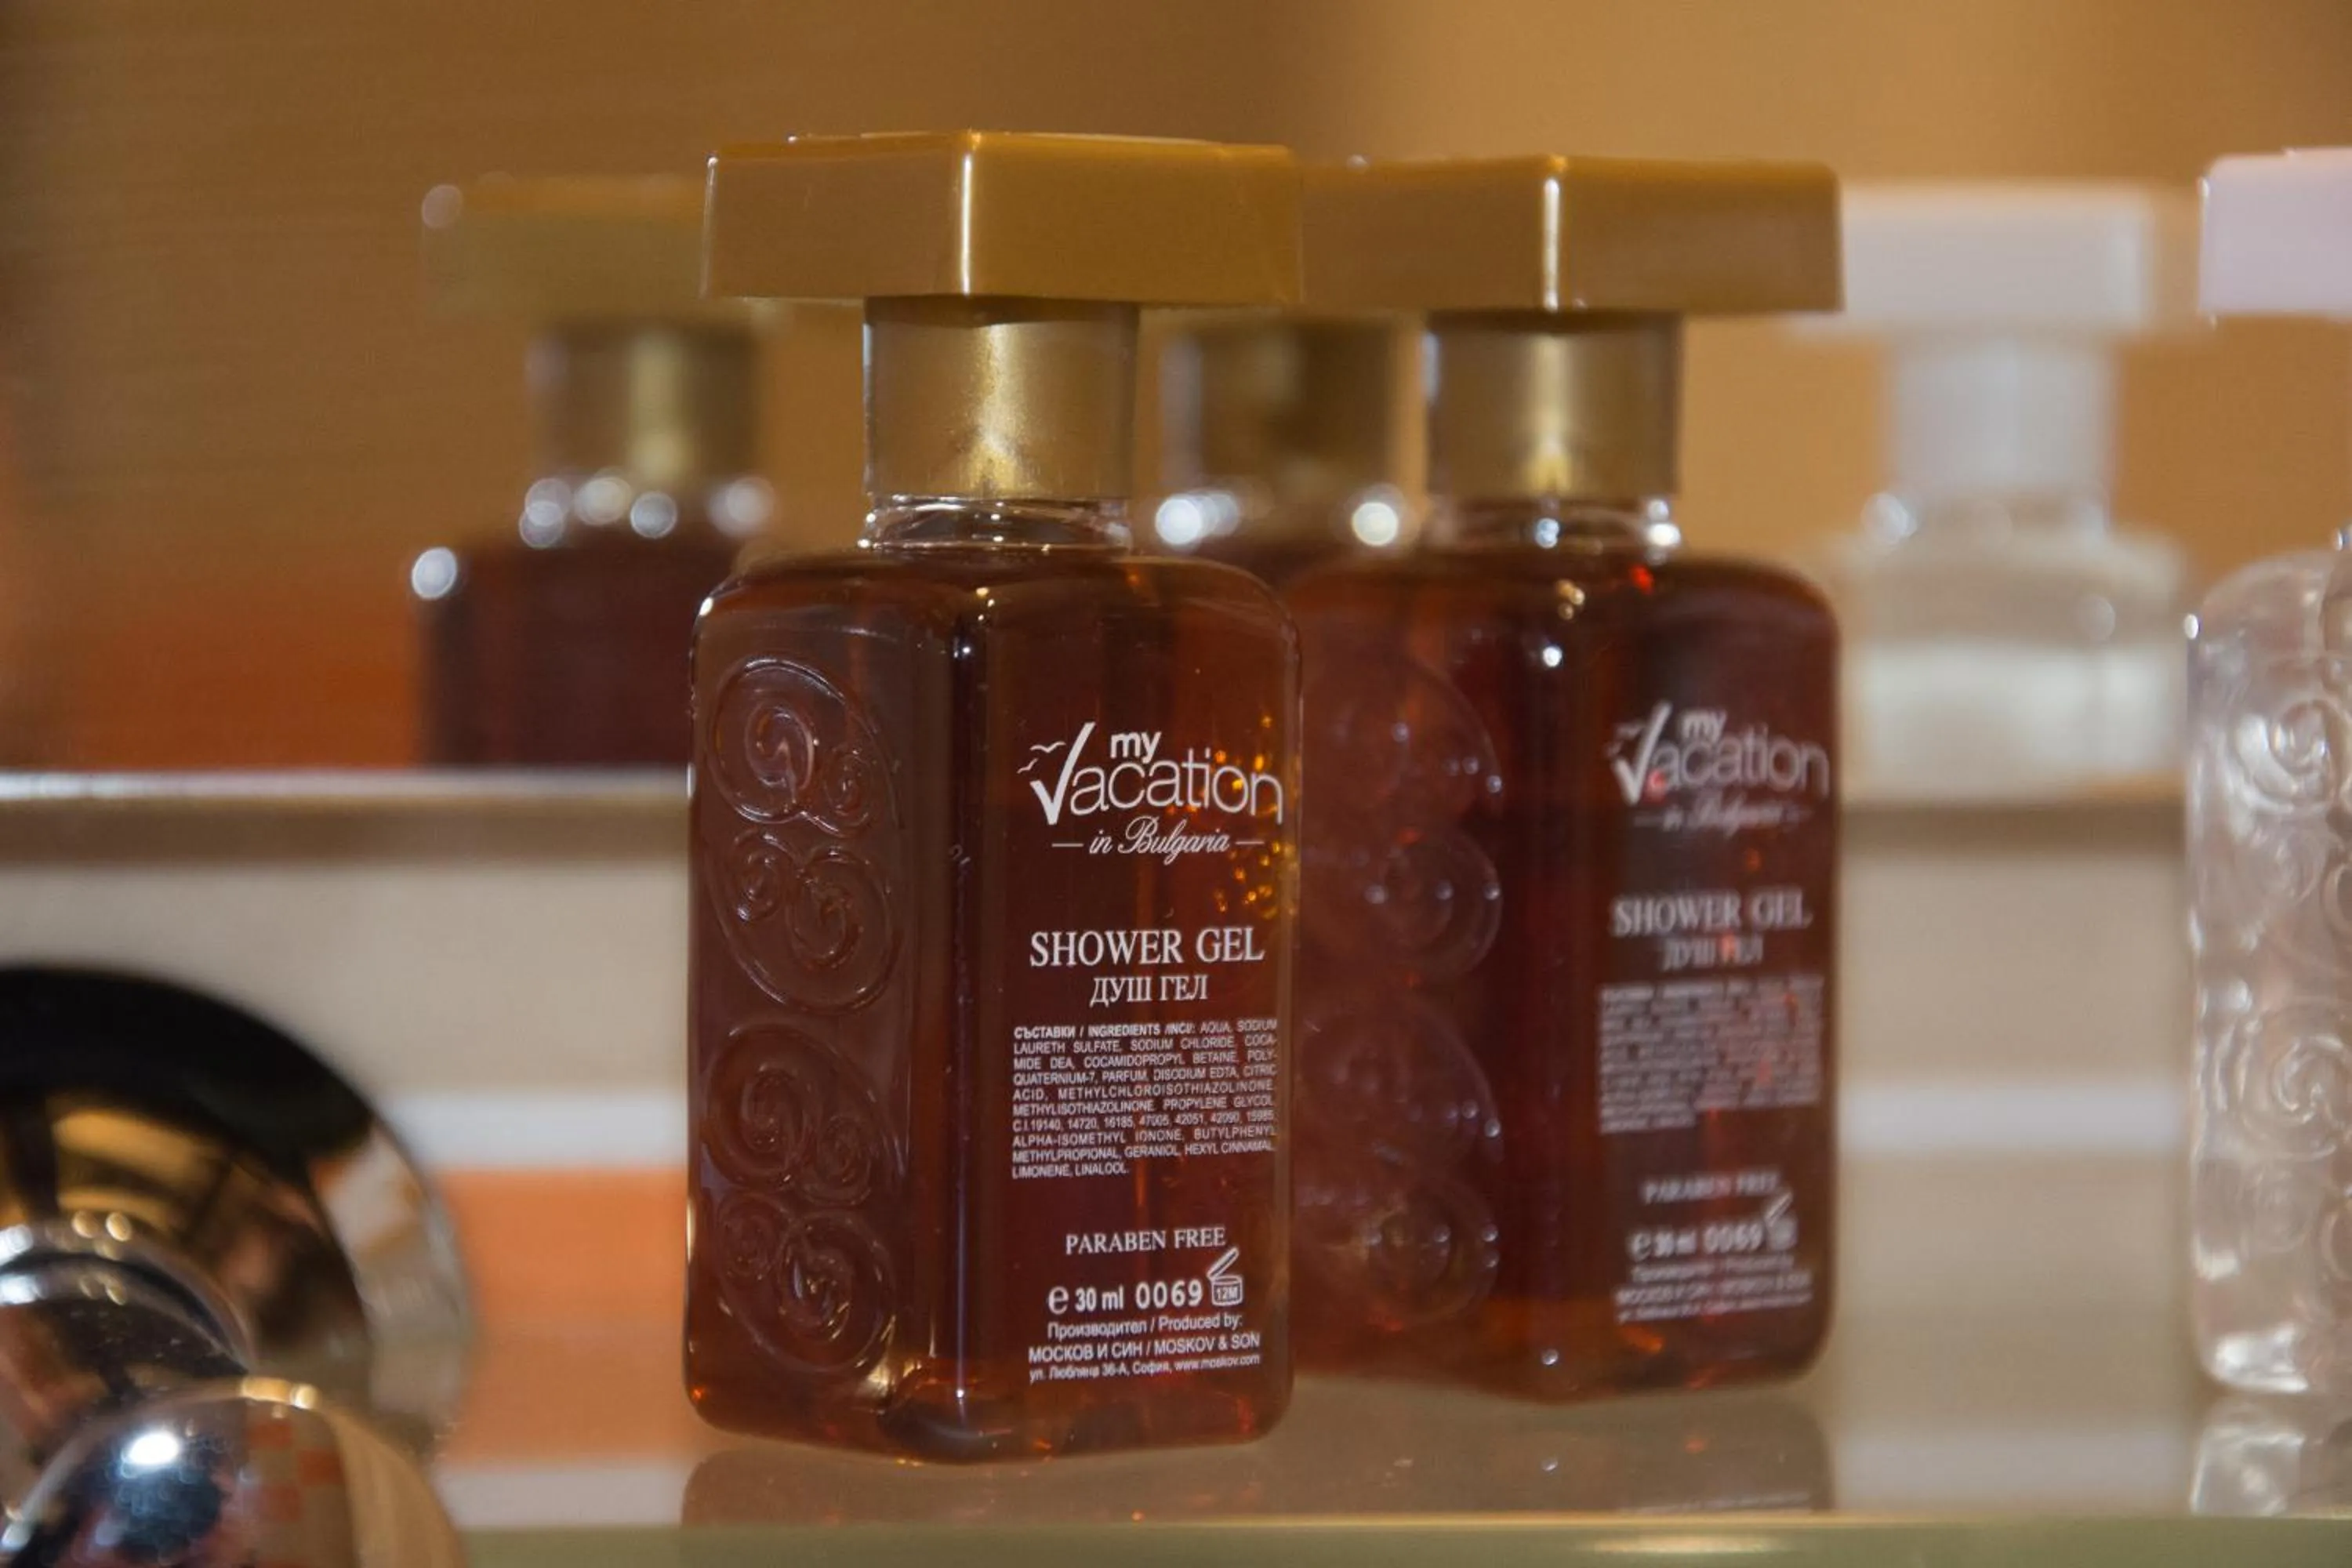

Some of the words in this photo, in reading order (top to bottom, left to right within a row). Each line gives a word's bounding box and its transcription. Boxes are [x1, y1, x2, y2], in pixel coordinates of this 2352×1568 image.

[1682, 710, 1727, 743] my
[1110, 731, 1162, 764] my
[1029, 721, 1283, 825] Vacation
[1090, 829, 1112, 854] in
[1118, 815, 1229, 866] Bulgaria
[1613, 895, 1741, 937] SHOWER
[1030, 930, 1184, 967] SHOWER
[1196, 927, 1265, 963] GEL
[1090, 976, 1152, 1007] ДУШ
[1160, 975, 1208, 1001] ГЕЛ
[1087, 1022, 1160, 1037] INGREDIENTS
[1236, 1019, 1277, 1032] SODIUM
[1014, 1041, 1065, 1054] LAURETH
[1131, 1038, 1174, 1051] SODIUM
[1014, 1056, 1042, 1069] MIDE
[1083, 1052, 1185, 1069] COCAMIDOPROPYL
[1153, 1068, 1206, 1081] DISODIUM
[1243, 1064, 1277, 1076] CITRIC
[1163, 1096, 1228, 1111] PROPYLENE
[1012, 1131, 1126, 1148] ALPHA-ISOMETHYL
[1193, 1125, 1276, 1140] BUTYLPHENYL
[1185, 1142, 1219, 1156] HEXYL
[1065, 1230, 1167, 1254] PARABEN
[1174, 1227, 1226, 1249] FREE
[1075, 1287, 1097, 1312] 30
[1102, 1285, 1123, 1310] ml
[1135, 1279, 1203, 1310] 0069
[1215, 1286, 1239, 1301] 12M
[1047, 1319, 1147, 1343] Производител
[1158, 1312, 1221, 1331] Produced
[1224, 1312, 1243, 1330] by:
[1029, 1345, 1094, 1364] МОСКОВ
[1098, 1342, 1108, 1360] И
[1111, 1341, 1143, 1359] СИН
[1154, 1336, 1215, 1356] MOSKOV
[1218, 1335, 1228, 1351] &
[1231, 1332, 1261, 1350] SON
